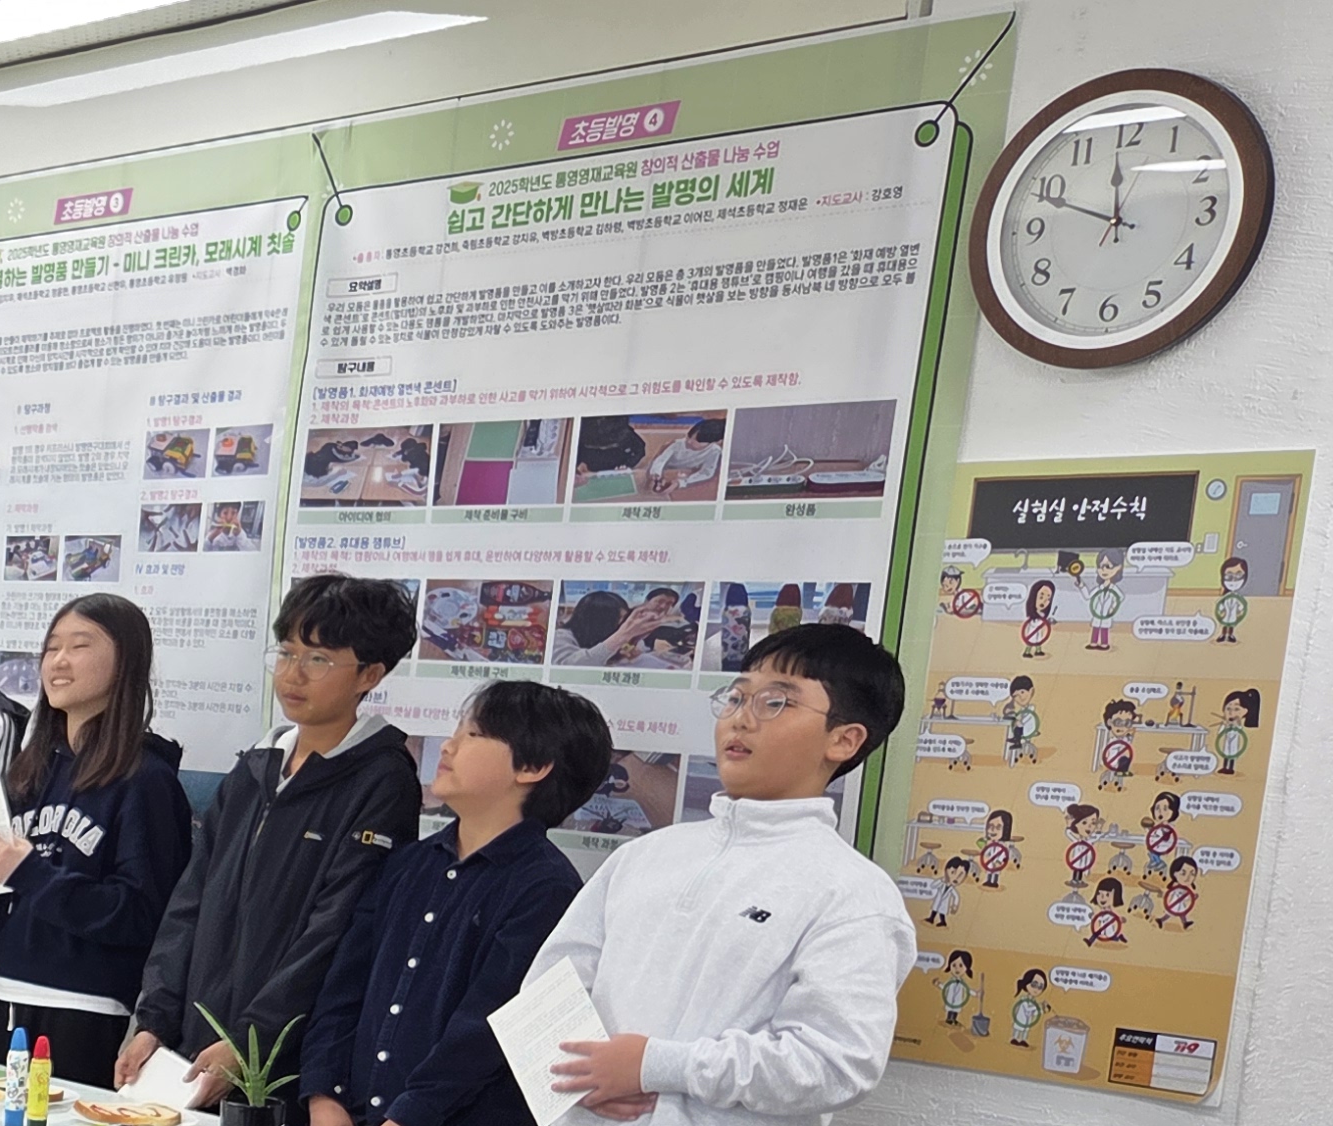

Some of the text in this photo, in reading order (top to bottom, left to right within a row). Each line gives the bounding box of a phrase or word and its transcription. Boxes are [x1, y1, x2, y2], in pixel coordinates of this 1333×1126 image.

[568, 111, 640, 145] 초등발명
[1116, 122, 1144, 149] 12
[1169, 125, 1179, 153] 1
[1071, 137, 1093, 166] 11
[488, 140, 780, 197] 2025학년도 통영영재교육원 창의적 산출물 나눔 수업
[1191, 154, 1212, 184] 2
[447, 167, 775, 235] 쉽고 간단하게 만나는 발명의 세계
[821, 186, 903, 207] 지도교사 강호영
[1036, 173, 1067, 203] 10
[60, 195, 107, 221] 초등발명
[1194, 195, 1218, 226] 3
[1025, 217, 1046, 246] 9
[31, 260, 68, 284] 발명품
[71, 255, 109, 280] 만들기
[123, 250, 149, 273] 미니
[153, 243, 199, 269] 크린카,
[204, 234, 263, 264] 모래시계
[267, 232, 295, 255] 칫솔
[1173, 242, 1195, 270] 4
[1031, 258, 1051, 286] 8
[1058, 287, 1077, 316] 7
[1098, 293, 1119, 322] 6
[1141, 280, 1164, 308] 5
[1012, 496, 1148, 524] 실험실 안전수칙
